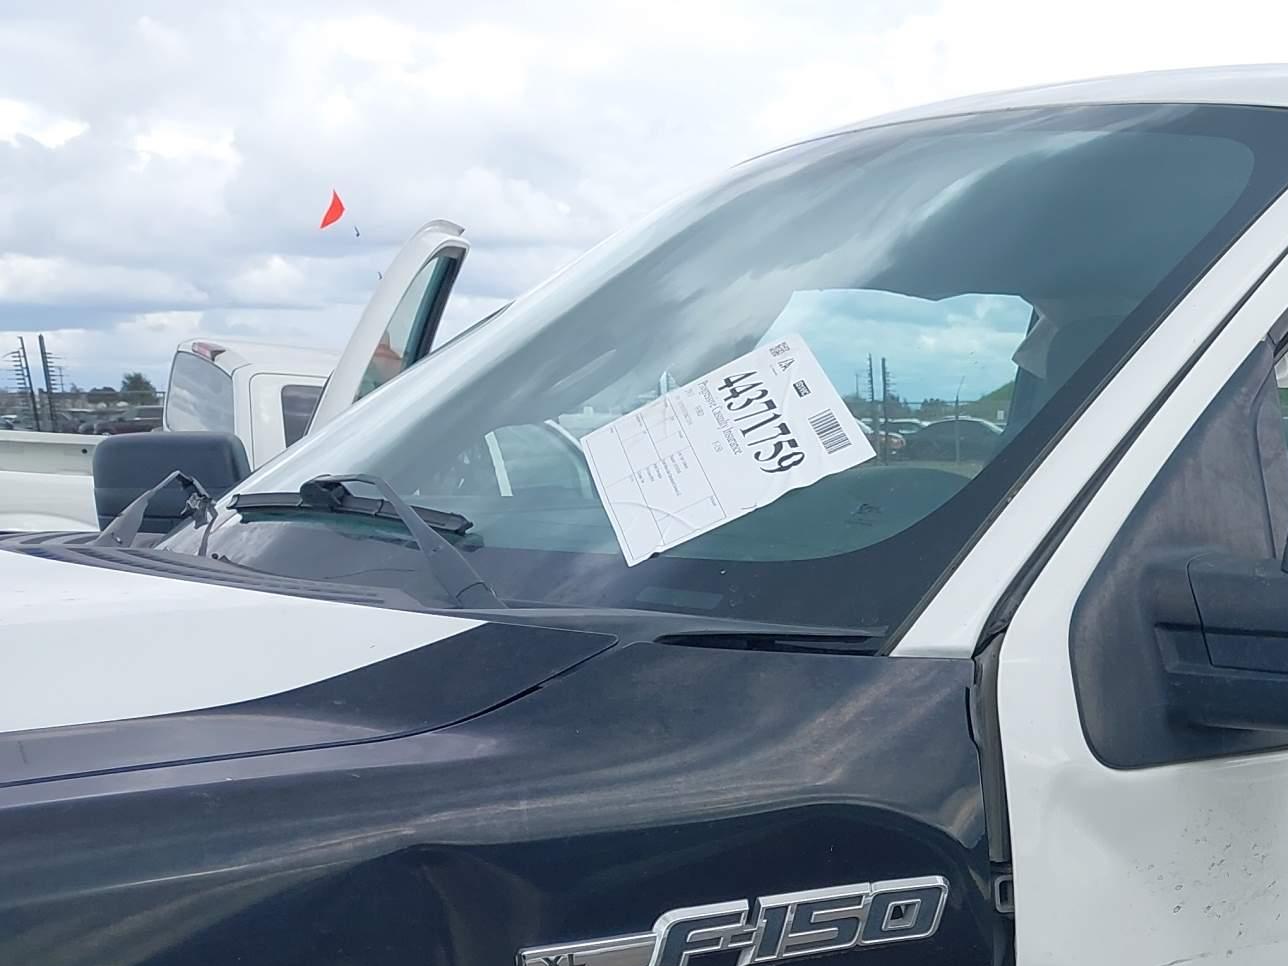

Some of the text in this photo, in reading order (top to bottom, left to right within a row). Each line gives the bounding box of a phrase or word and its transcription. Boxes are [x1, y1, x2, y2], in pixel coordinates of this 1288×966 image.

[711, 404, 732, 432] Casualty
[722, 425, 743, 456] Insurance
[718, 371, 806, 474] 44371759
